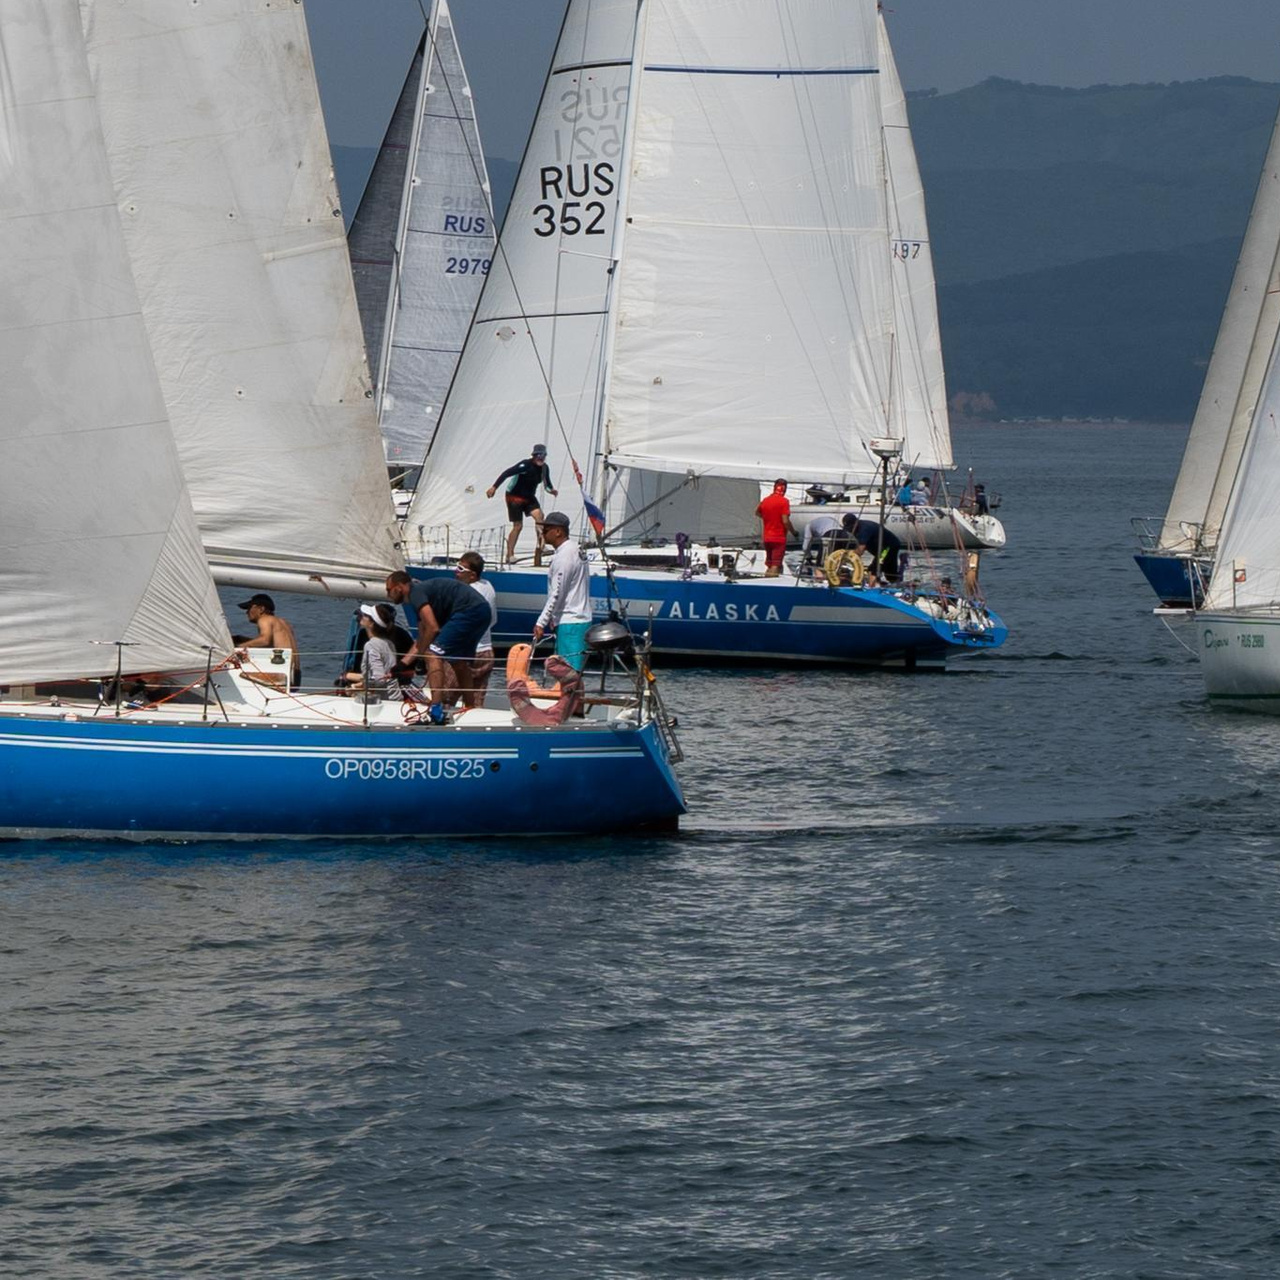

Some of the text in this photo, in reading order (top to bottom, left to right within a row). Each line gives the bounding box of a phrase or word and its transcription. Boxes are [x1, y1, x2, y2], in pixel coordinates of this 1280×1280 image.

[540, 162, 614, 200] RUS
[444, 214, 486, 234] RUS
[445, 257, 492, 275] 2979
[669, 600, 781, 620] ALASKA
[325, 759, 486, 781] OP0958RUS25
